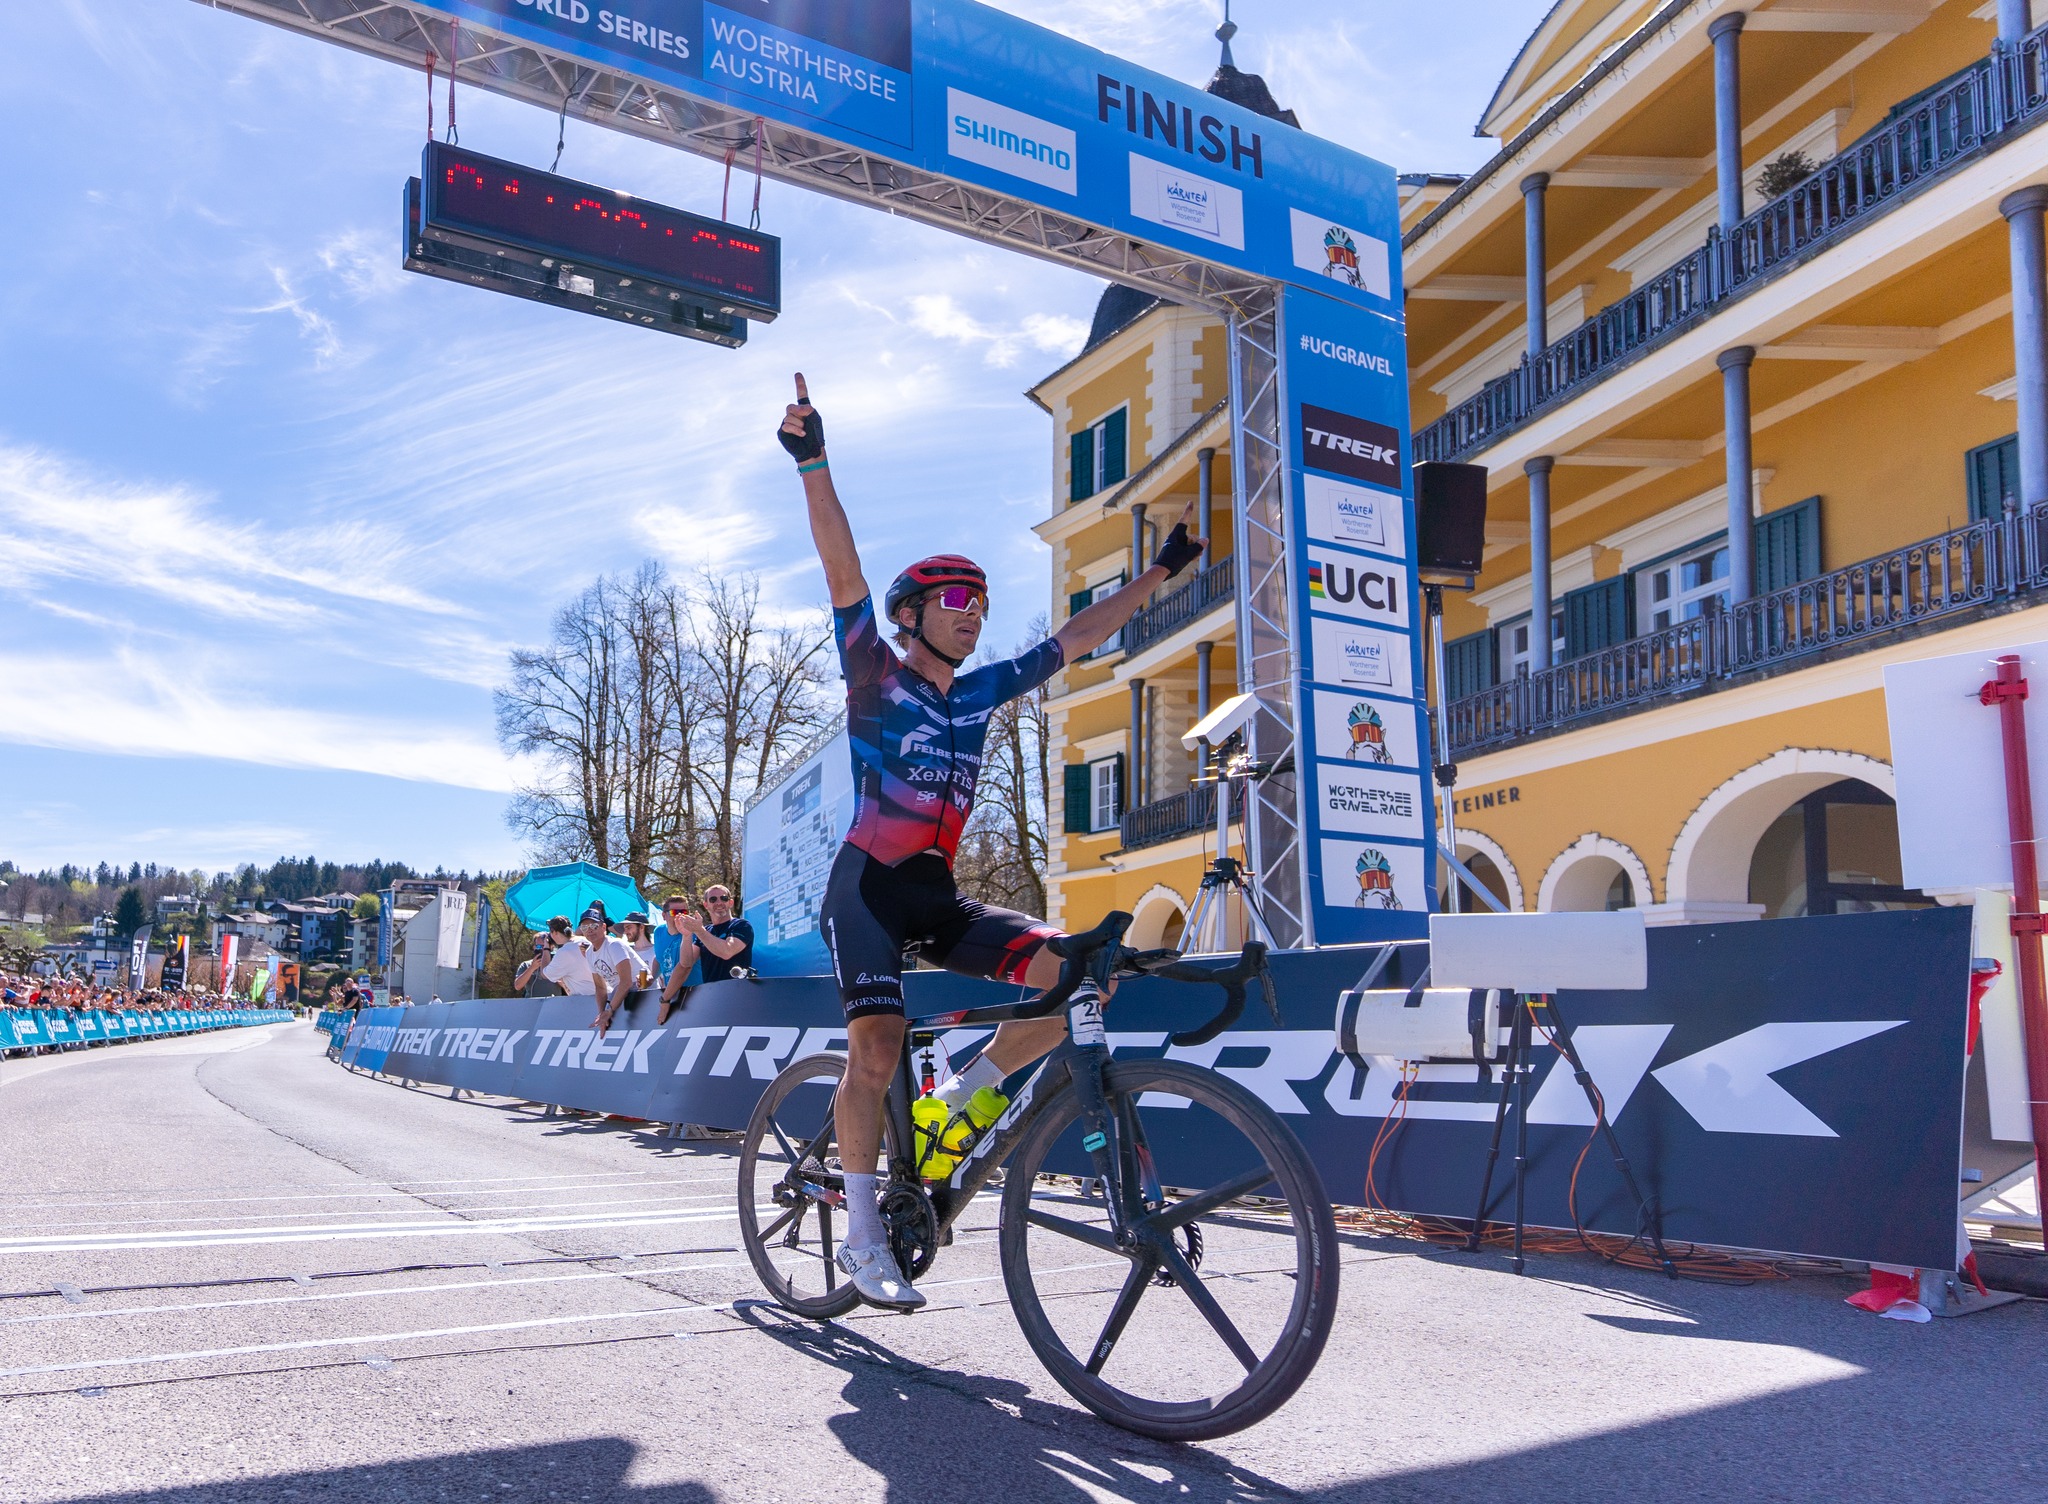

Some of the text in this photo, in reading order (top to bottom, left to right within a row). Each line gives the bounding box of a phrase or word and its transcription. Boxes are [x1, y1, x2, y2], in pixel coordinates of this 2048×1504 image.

[597, 10, 690, 59] SERIES
[710, 17, 897, 102] WOERTHERSEE
[709, 50, 819, 104] AUSTRIA
[954, 115, 1070, 172] SHIMANO
[1097, 73, 1263, 180] FINISH
[1300, 335, 1394, 377] #UCIGRAVEL
[1305, 427, 1397, 466] TREK
[1325, 563, 1398, 614] UCI
[1380, 803, 1412, 817] RACE
[391, 1028, 442, 1056] TREK
[438, 1027, 529, 1064] TREK
[530, 1029, 667, 1074] TREK
[950, 1067, 1043, 1190] FELT
[839, 1243, 863, 1277] nimbl
